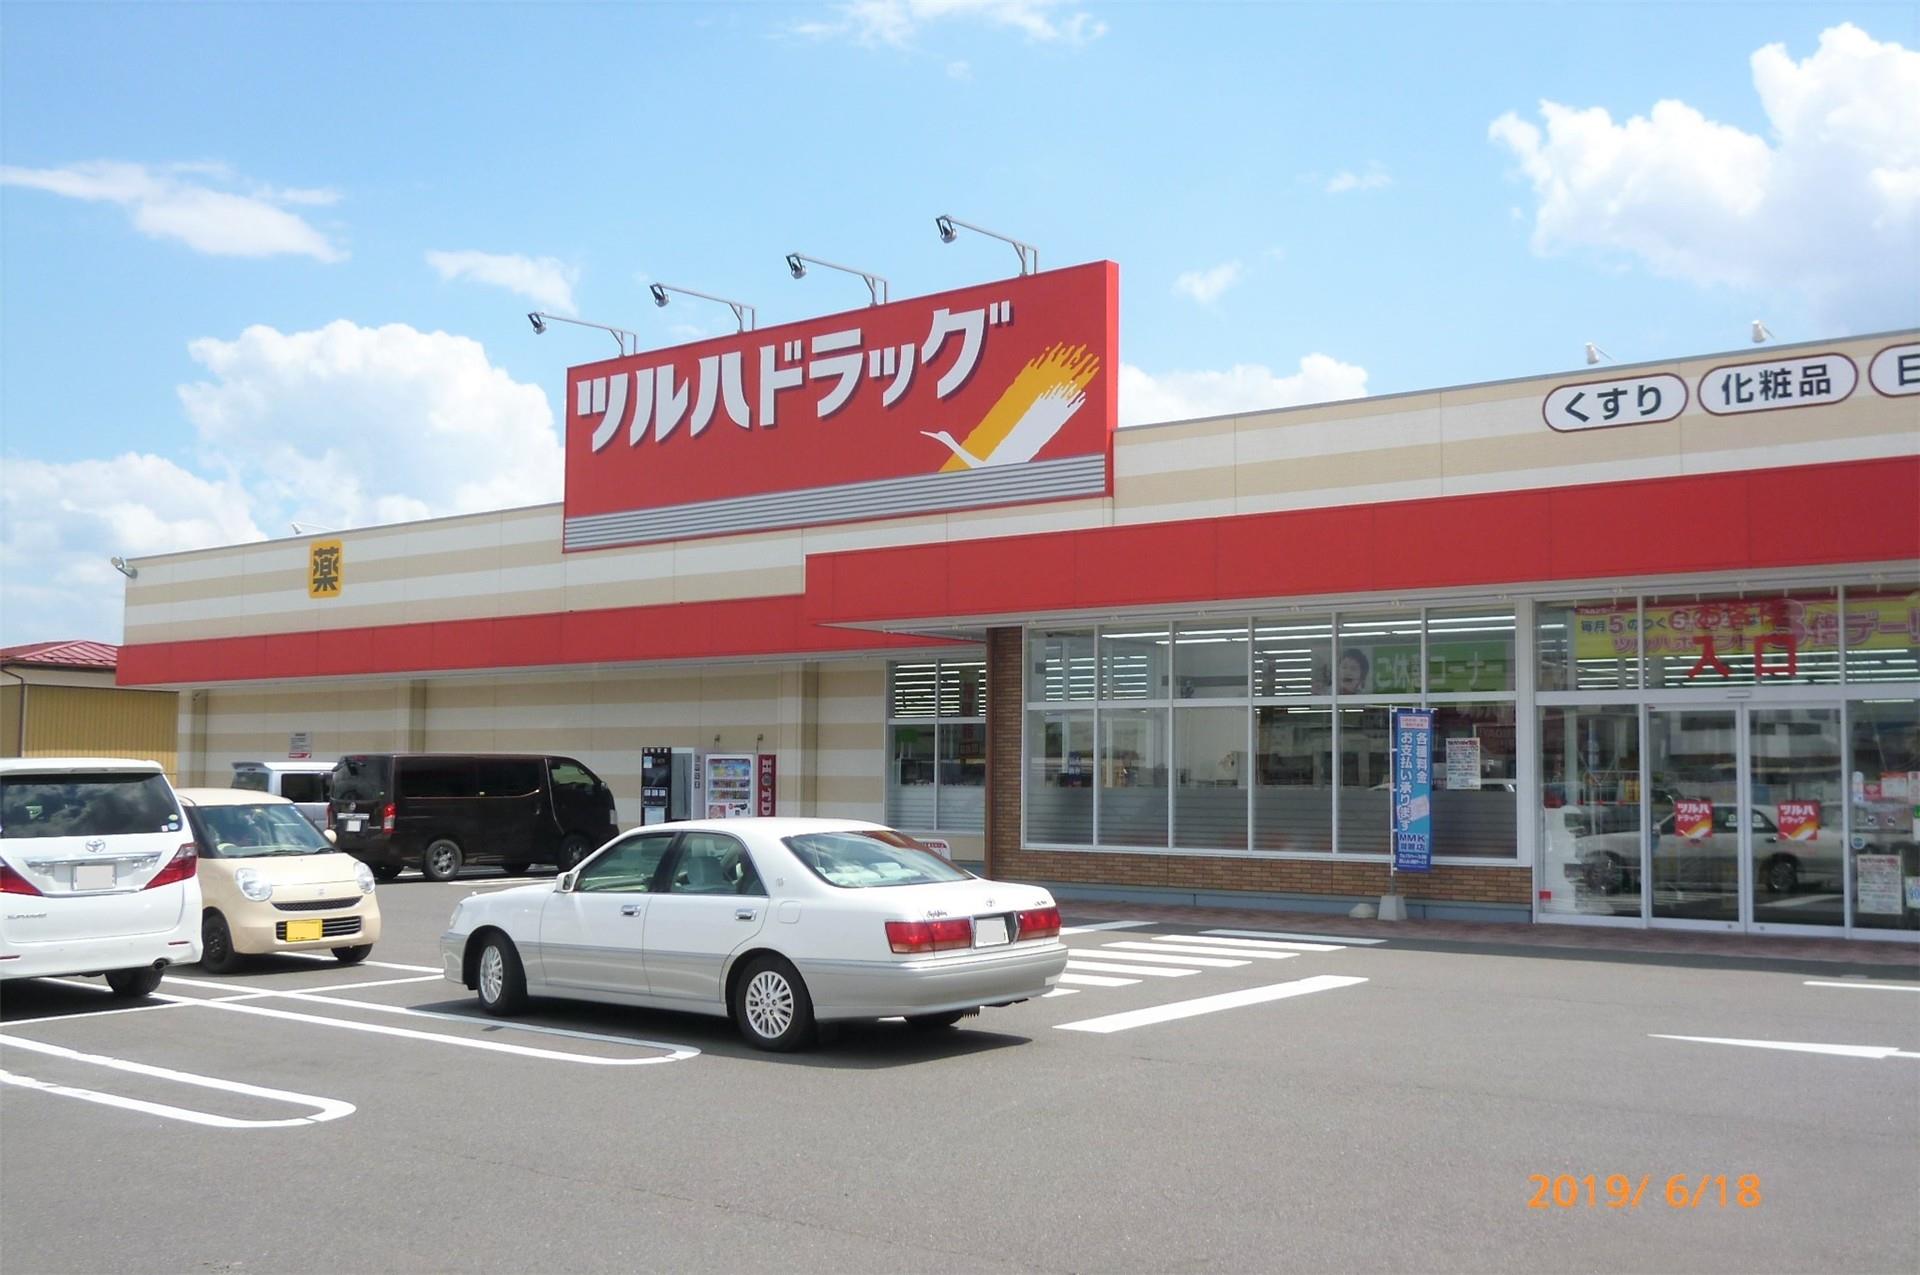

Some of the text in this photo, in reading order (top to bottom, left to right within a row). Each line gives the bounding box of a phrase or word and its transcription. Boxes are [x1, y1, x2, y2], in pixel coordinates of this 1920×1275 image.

[577, 300, 1010, 453] ツルハドラッグ
[1721, 363, 1831, 405] 化粧品
[1565, 384, 1662, 422] くすり
[313, 546, 339, 592] 薬
[1687, 635, 1797, 678] 入口
[1677, 803, 1710, 814] ツルハ
[1780, 804, 1815, 816] ツルハ
[1400, 834, 1425, 842] MMK
